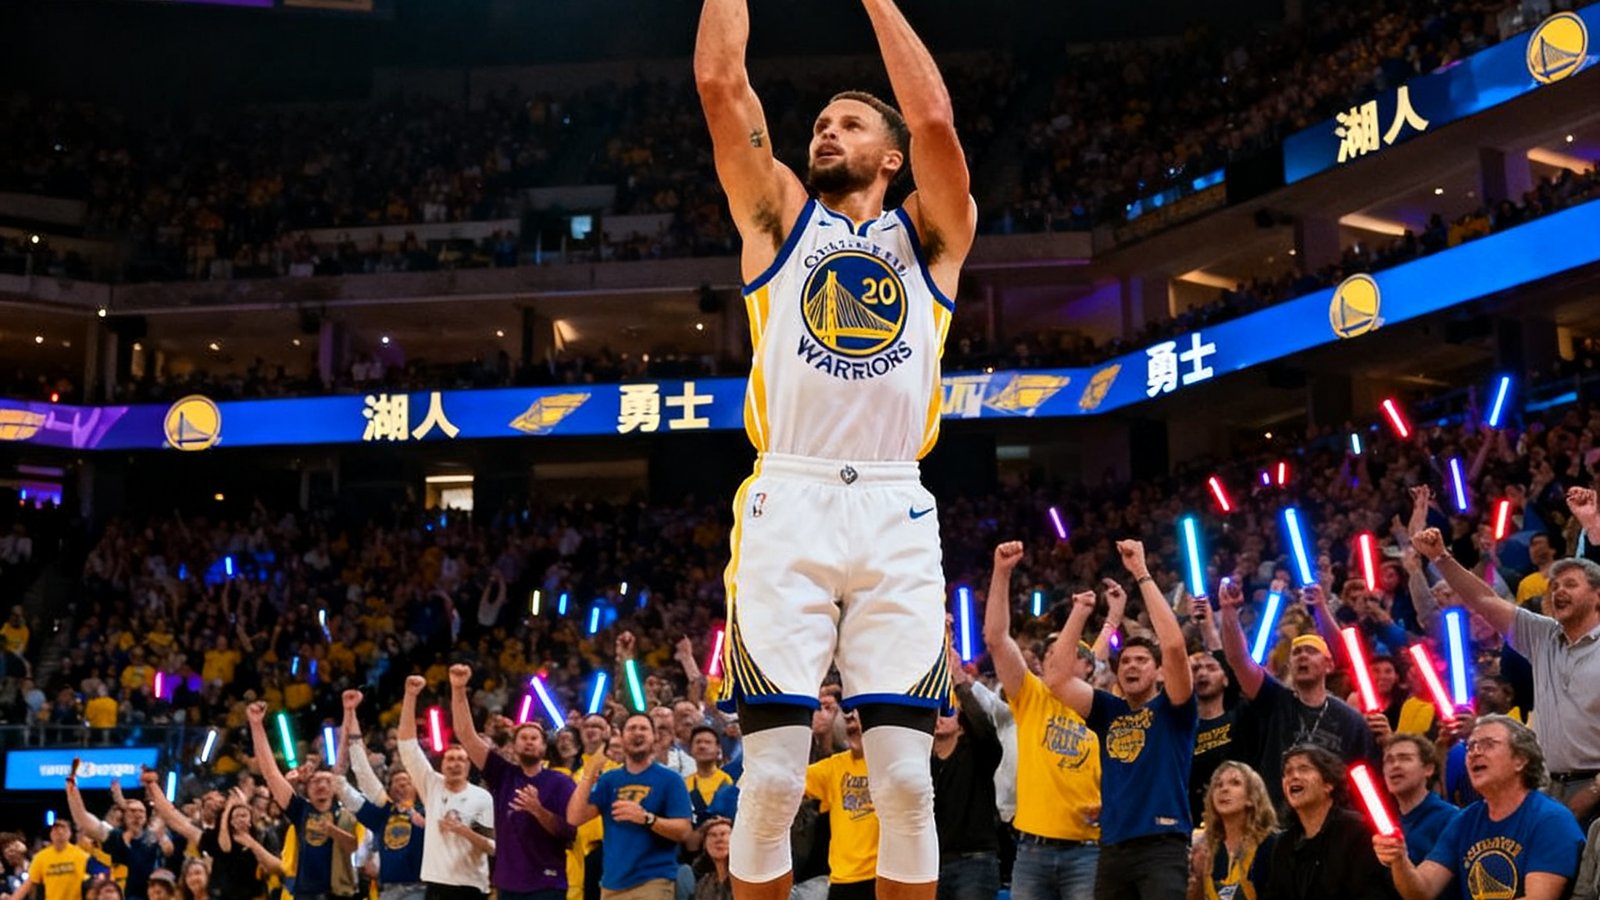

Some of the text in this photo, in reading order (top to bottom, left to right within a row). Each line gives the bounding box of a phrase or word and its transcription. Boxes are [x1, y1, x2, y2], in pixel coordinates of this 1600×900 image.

[1335, 86, 1429, 163] 湖人
[861, 277, 897, 305] 20
[1146, 333, 1216, 397] 勇士
[362, 392, 460, 441] 湖人
[616, 381, 714, 434] 勇士
